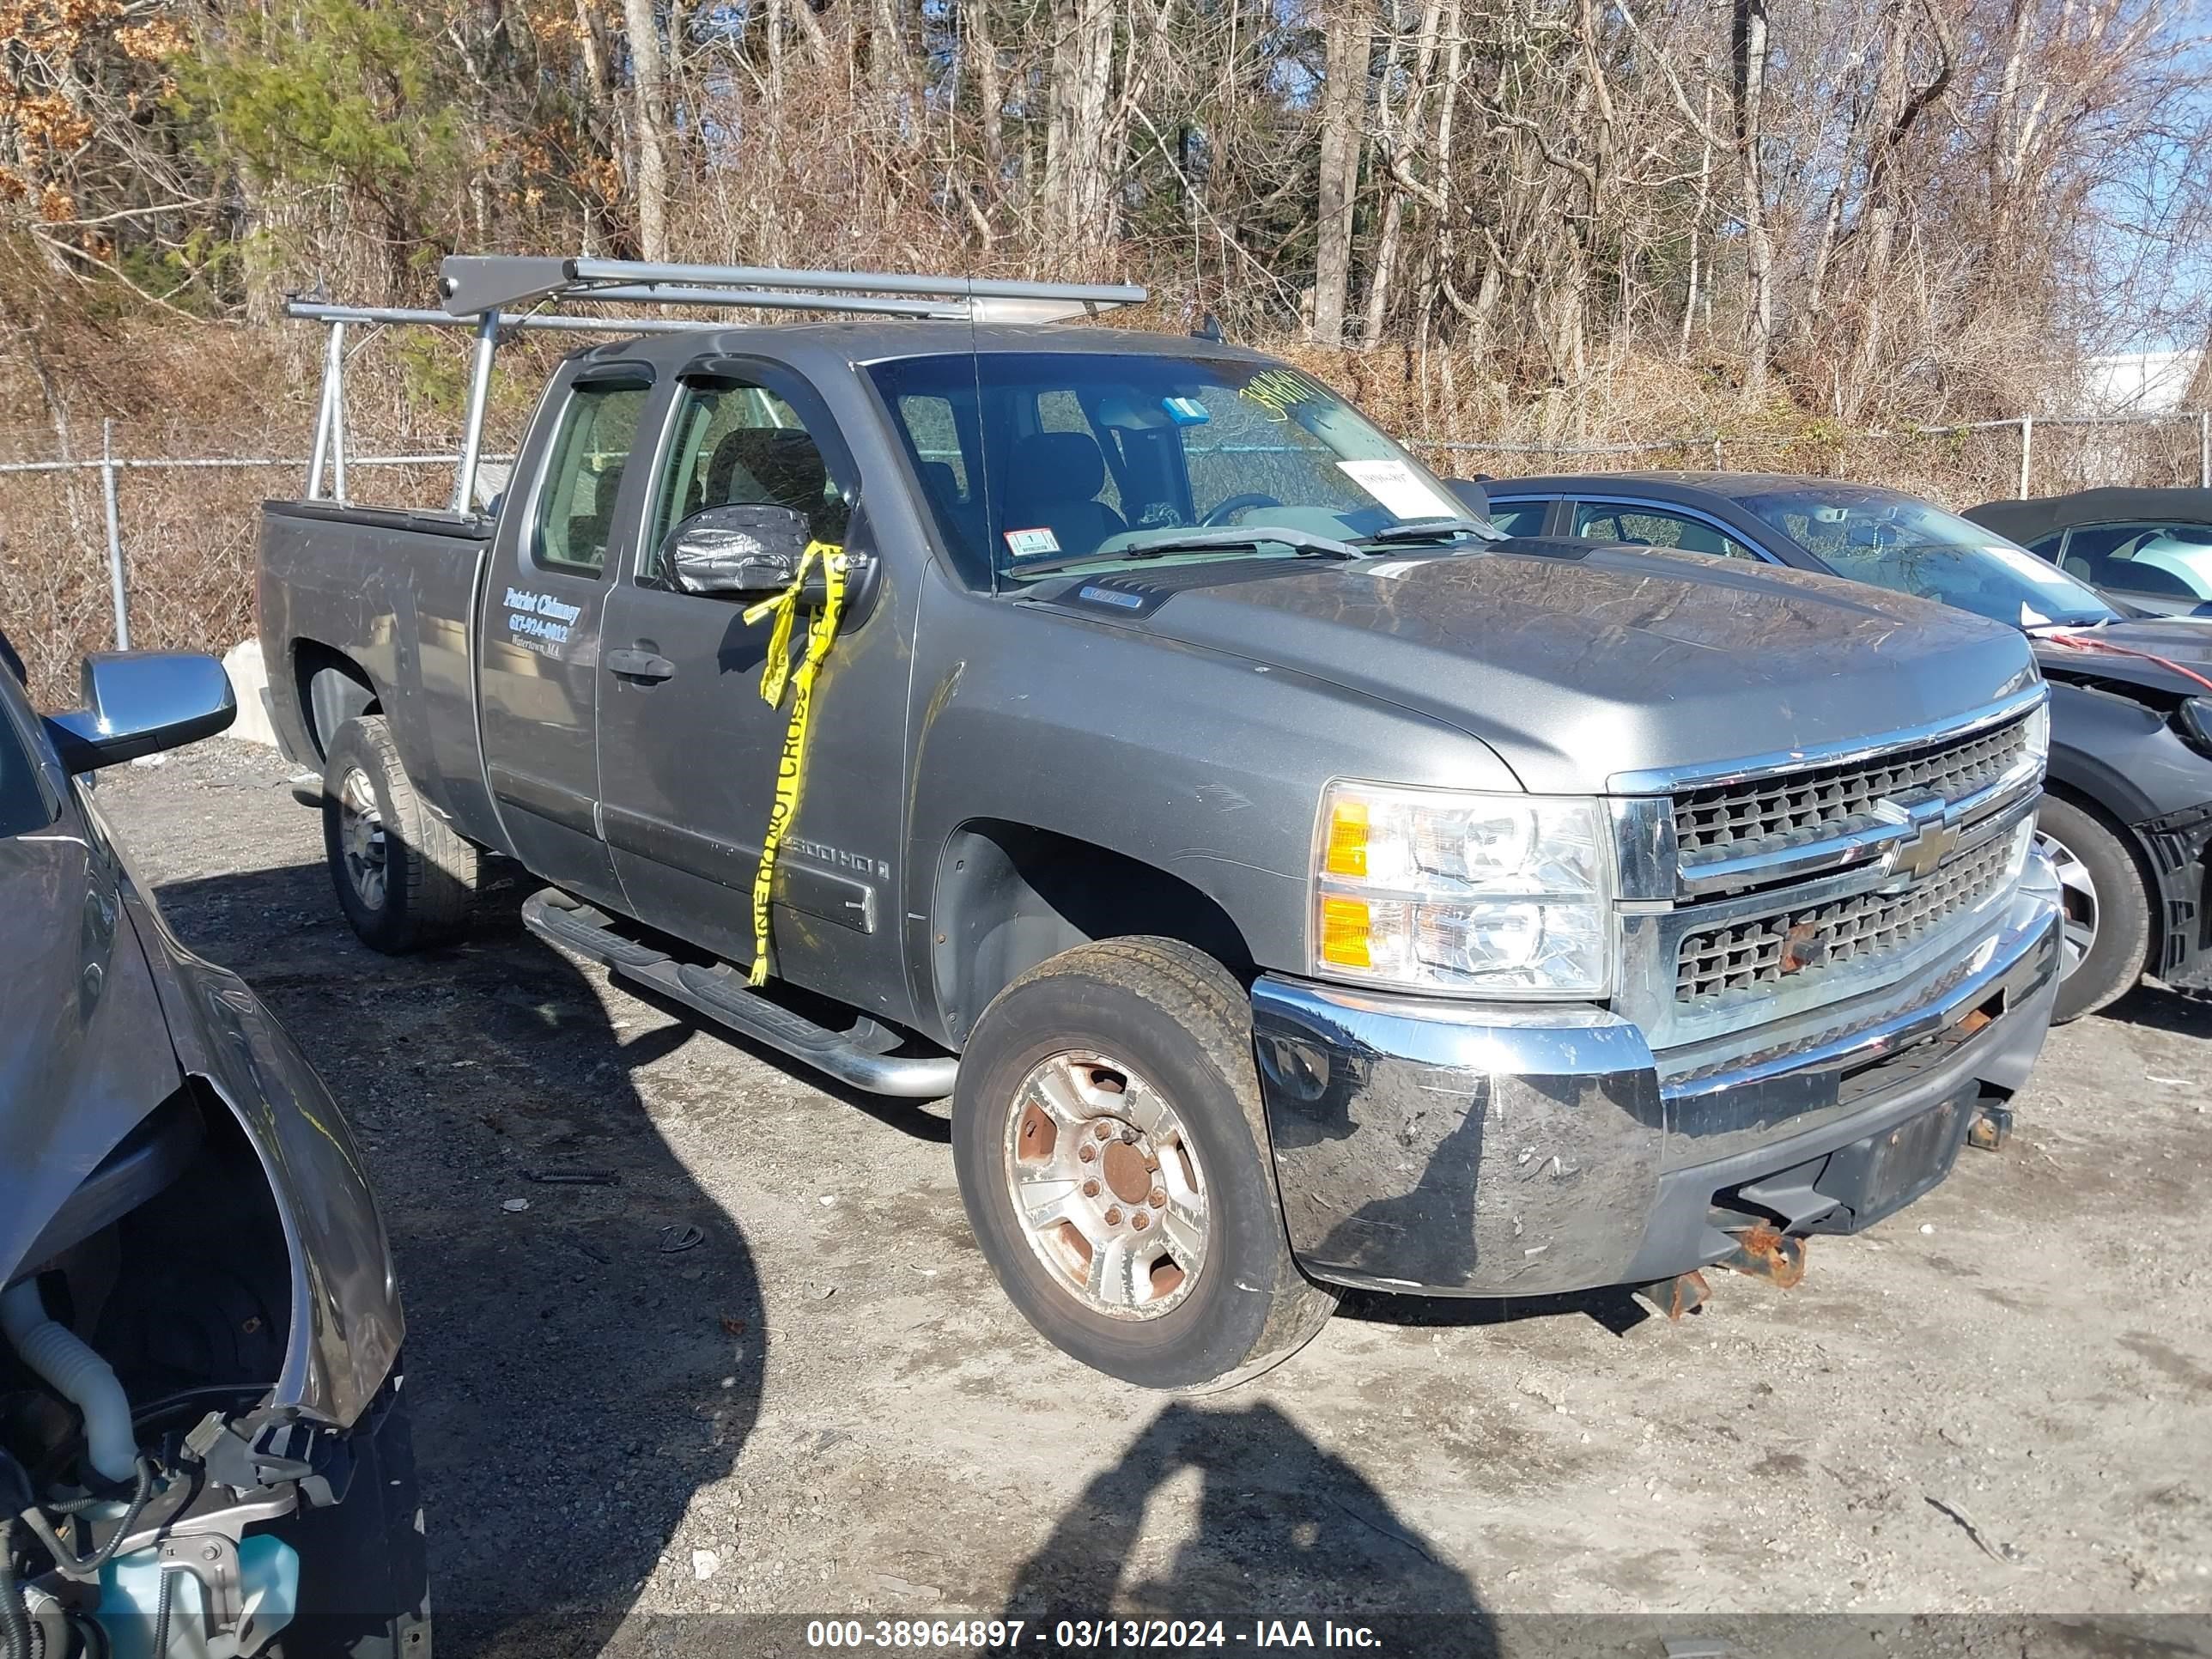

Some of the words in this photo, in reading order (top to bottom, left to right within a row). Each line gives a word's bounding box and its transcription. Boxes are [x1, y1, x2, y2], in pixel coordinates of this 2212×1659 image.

[502, 586, 538, 612] Patriot
[537, 594, 581, 627] Chimney
[778, 688, 807, 778] CROSS
[839, 848, 873, 874] HD
